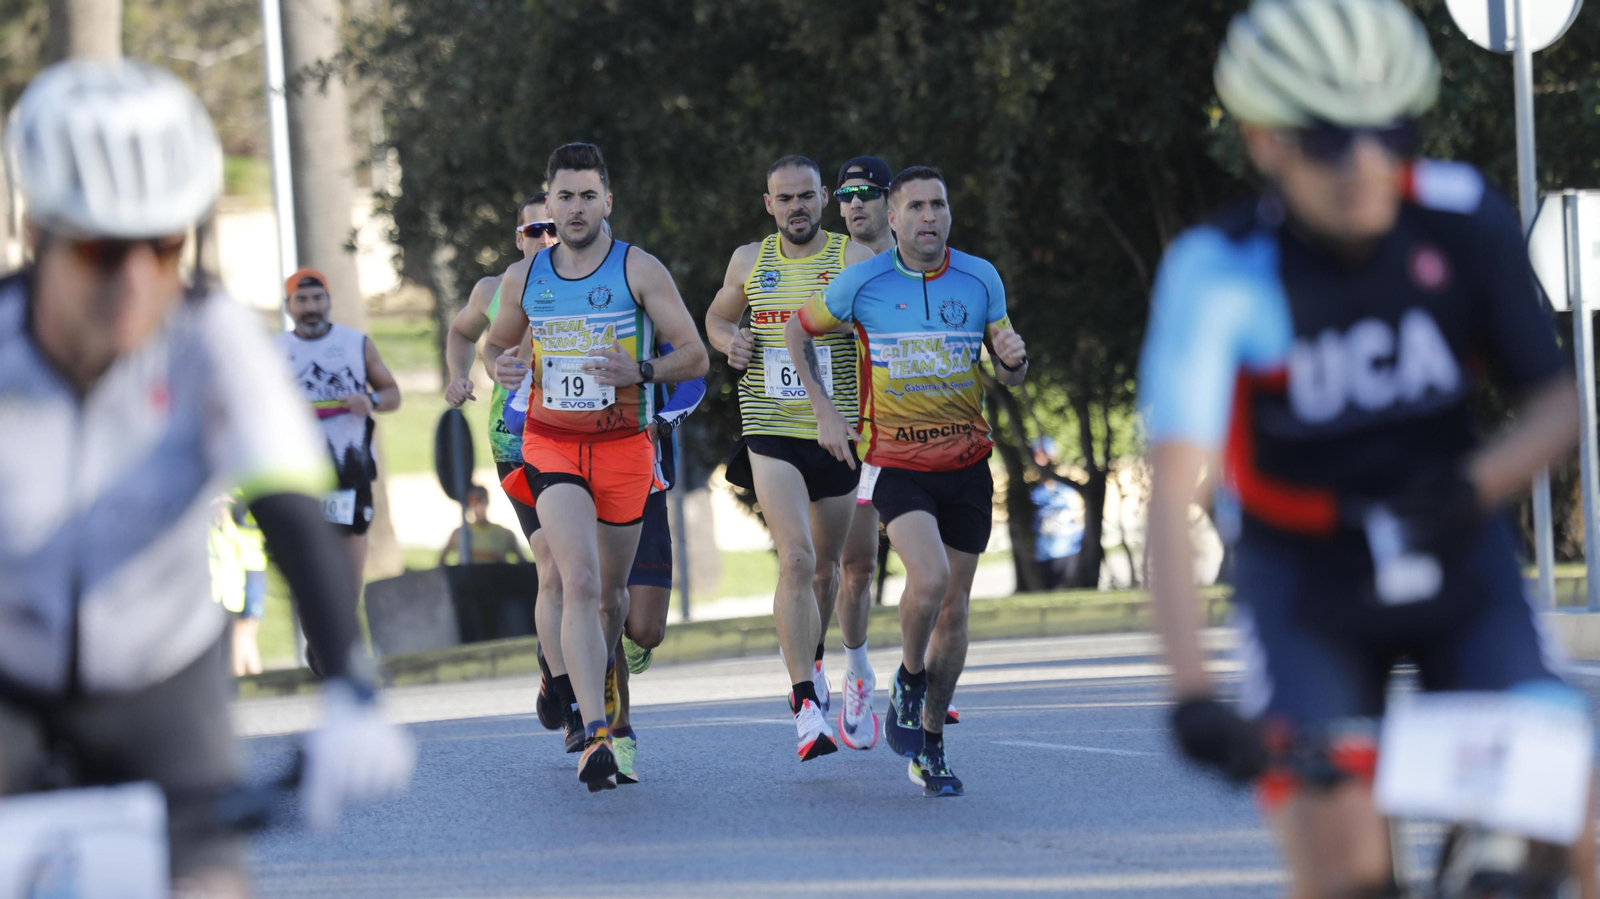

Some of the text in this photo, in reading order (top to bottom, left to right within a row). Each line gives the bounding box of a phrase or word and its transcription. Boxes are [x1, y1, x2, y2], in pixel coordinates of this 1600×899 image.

[545, 320, 586, 335] TRAIL
[541, 336, 577, 349] TEAM
[900, 338, 945, 358] TRAIL
[891, 359, 935, 375] TEAM
[1289, 308, 1461, 424] UCA
[561, 376, 584, 397] 19
[904, 383, 940, 393] Gabarras
